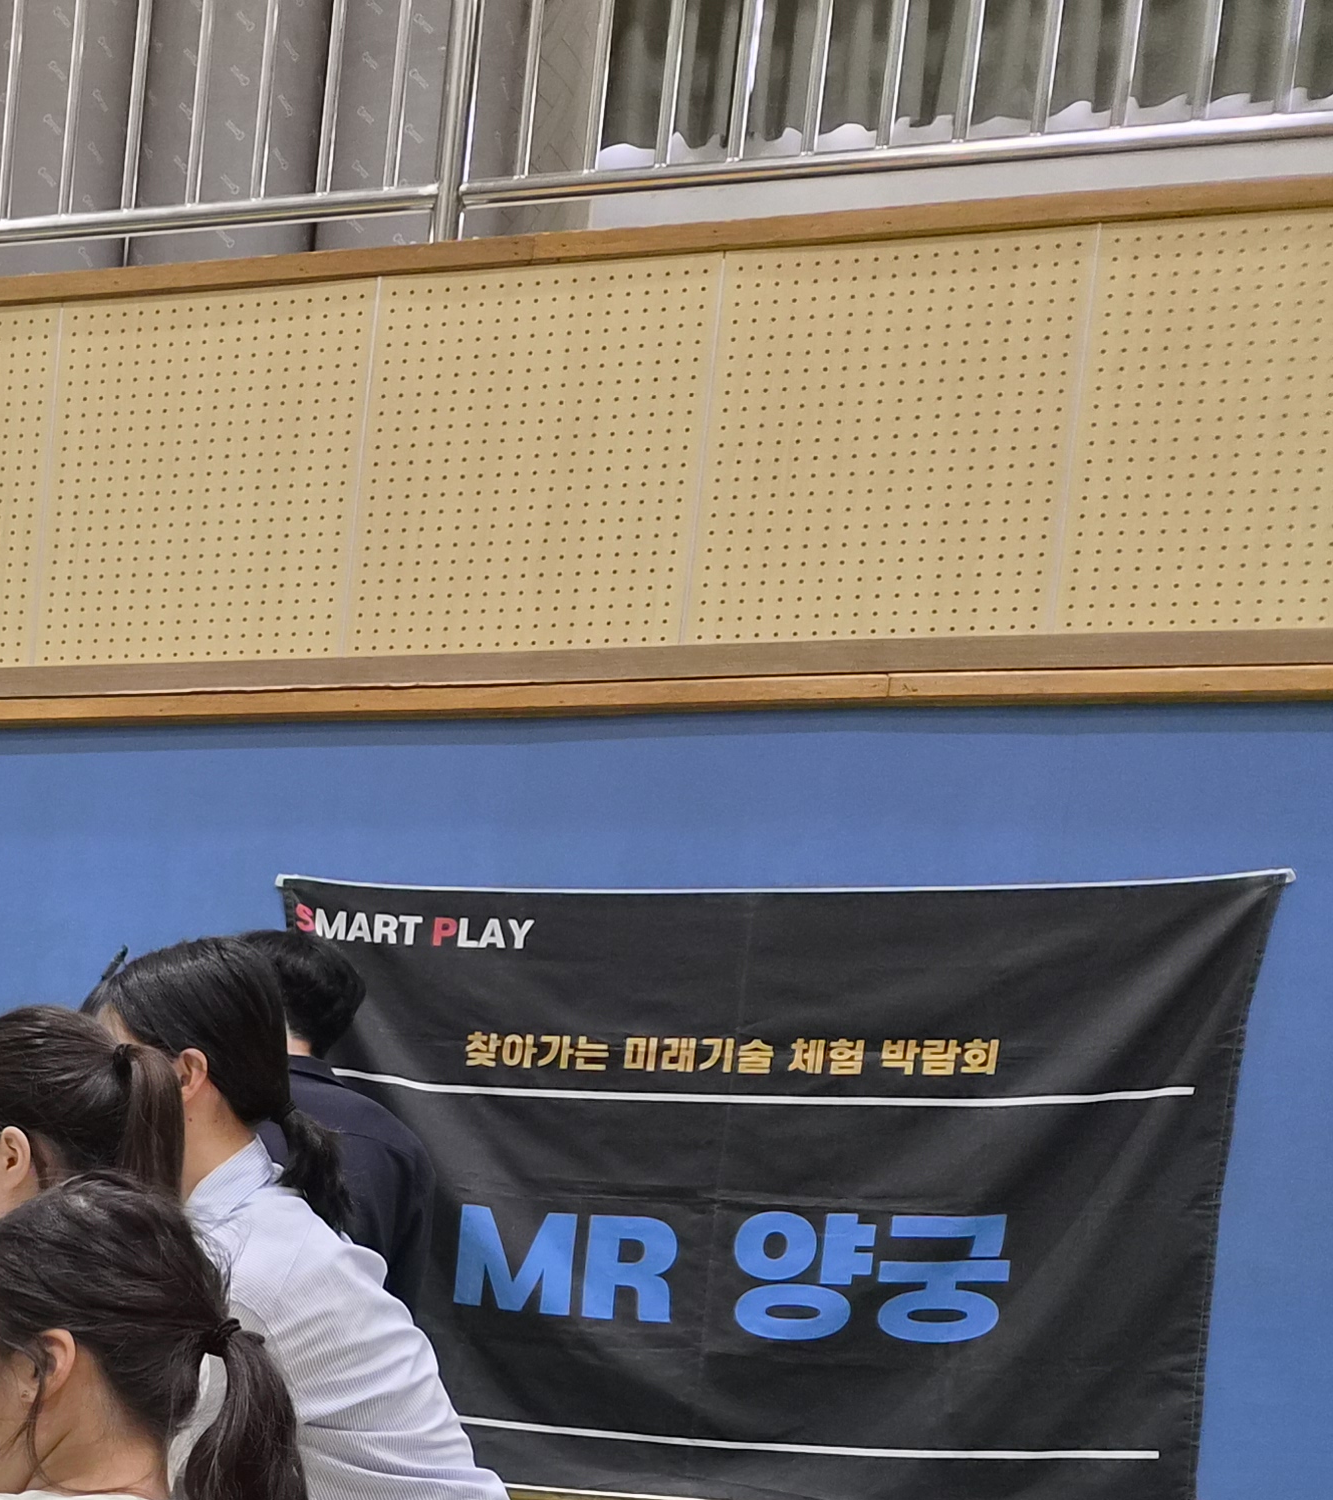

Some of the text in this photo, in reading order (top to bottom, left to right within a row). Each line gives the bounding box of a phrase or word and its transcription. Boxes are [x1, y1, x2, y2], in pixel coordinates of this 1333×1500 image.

[295, 903, 534, 949] SMART PLAY
[465, 1031, 1000, 1075] 찾아가는 미래기술 체험 박람회
[452, 1203, 1010, 1343] MR 양궁
